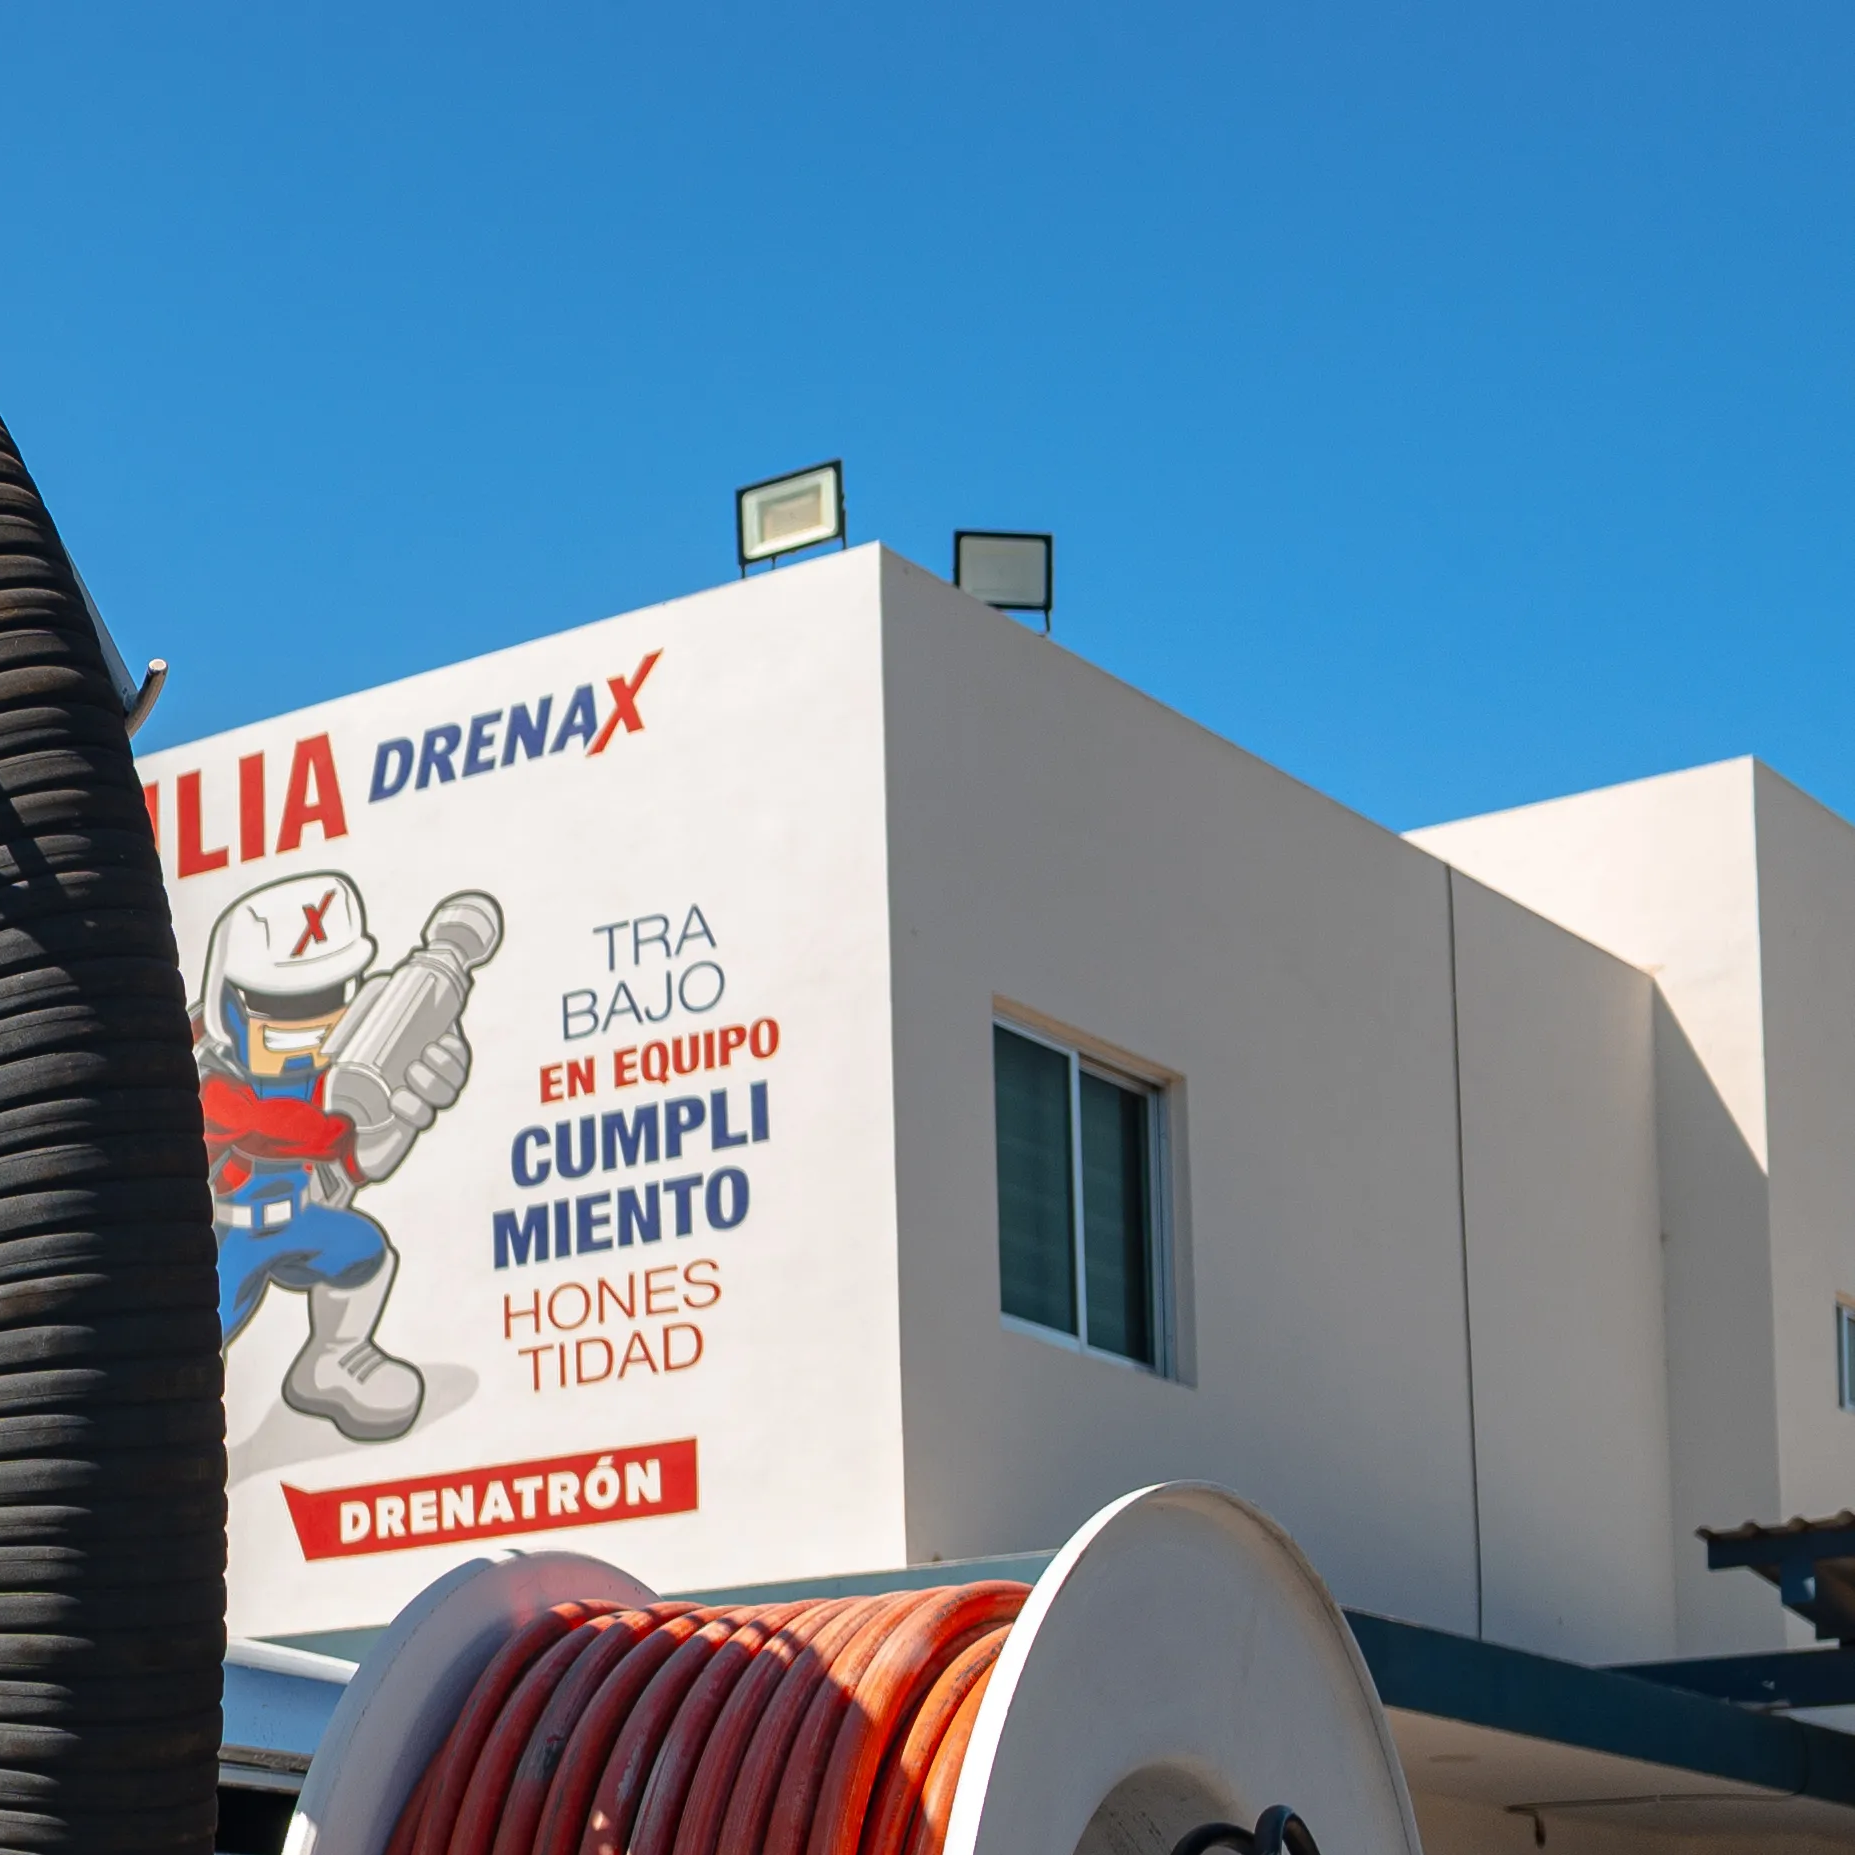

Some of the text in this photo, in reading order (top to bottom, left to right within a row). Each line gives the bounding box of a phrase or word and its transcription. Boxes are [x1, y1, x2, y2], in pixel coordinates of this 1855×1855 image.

[368, 648, 664, 803] DRENAX
[593, 904, 717, 971] TRA
[561, 961, 726, 1041] BAJO
[539, 1018, 780, 1104] EN EQUIPO
[510, 1081, 770, 1188] CUMPLI
[492, 1167, 750, 1271] MIENTO
[502, 1258, 722, 1340] HONES
[518, 1322, 705, 1393] TIDAD
[339, 1456, 663, 1545] DRENATRÓN
